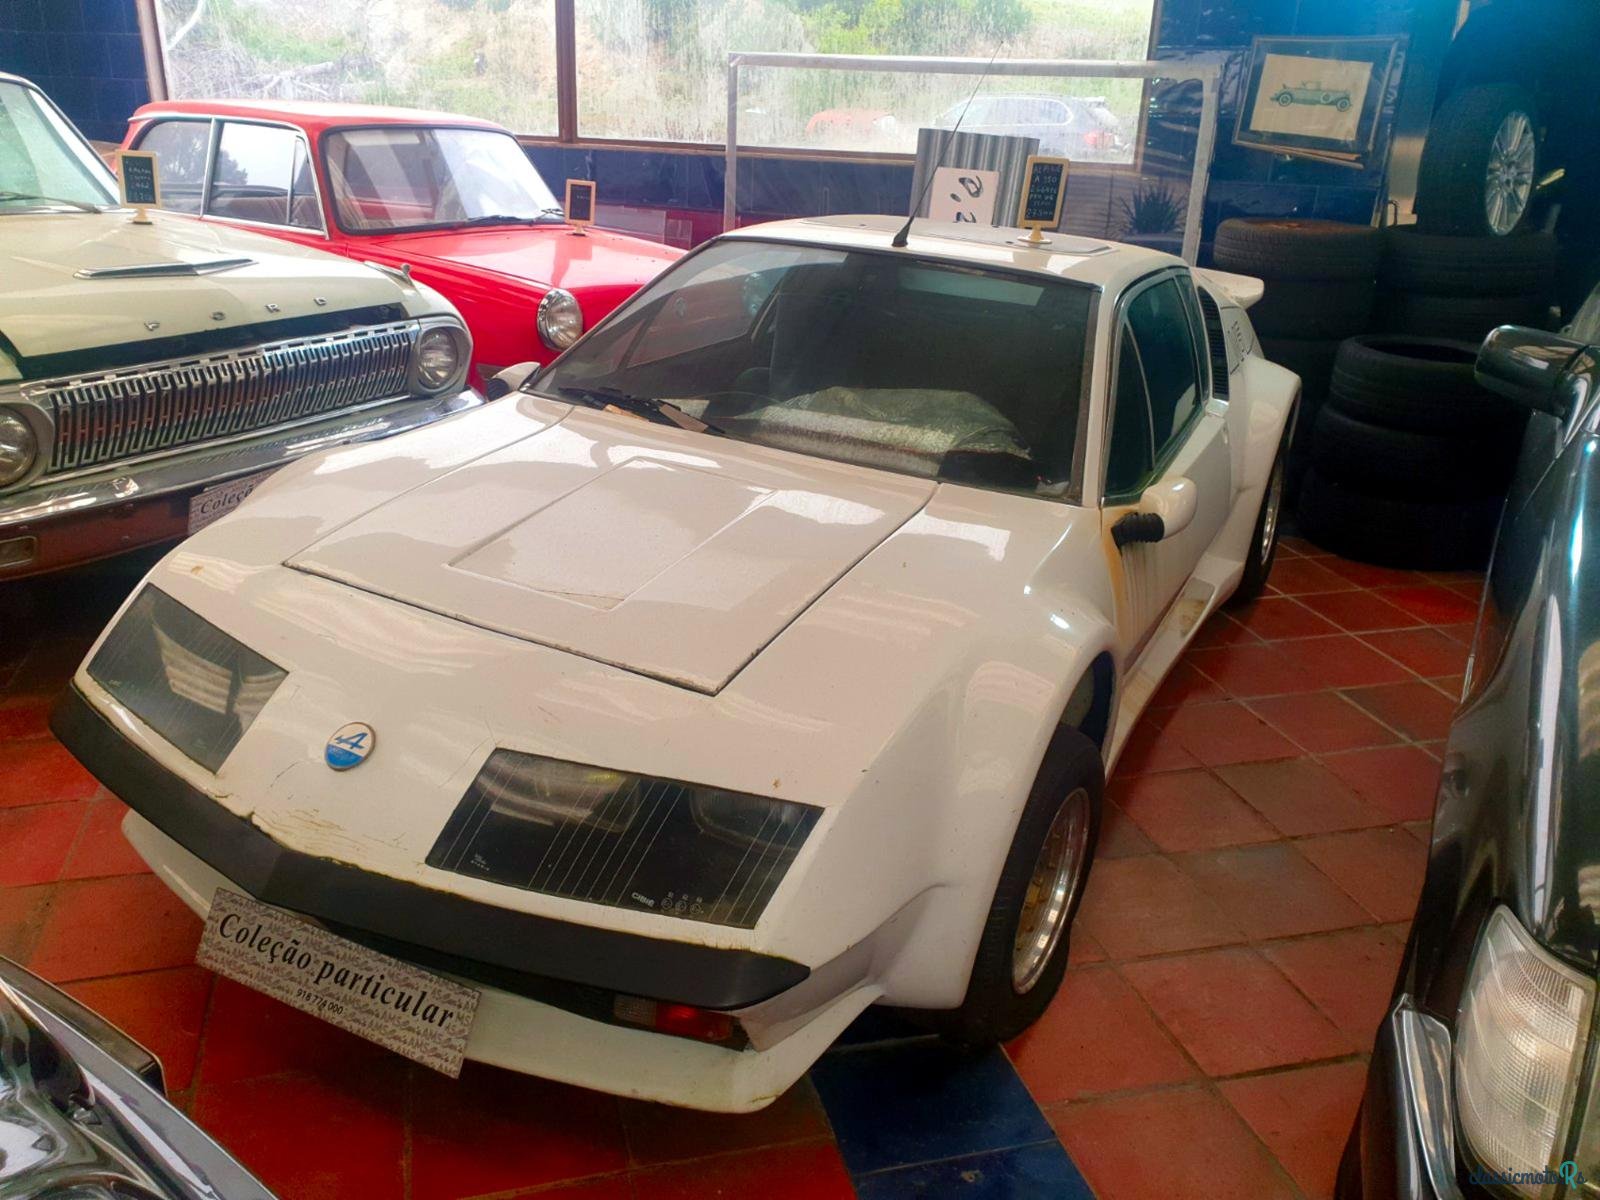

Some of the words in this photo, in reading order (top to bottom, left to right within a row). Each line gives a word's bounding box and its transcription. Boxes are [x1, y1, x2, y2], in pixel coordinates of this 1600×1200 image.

[219, 913, 312, 970] Coleção
[314, 959, 455, 1029] particular
[328, 1001, 344, 1015] 000
